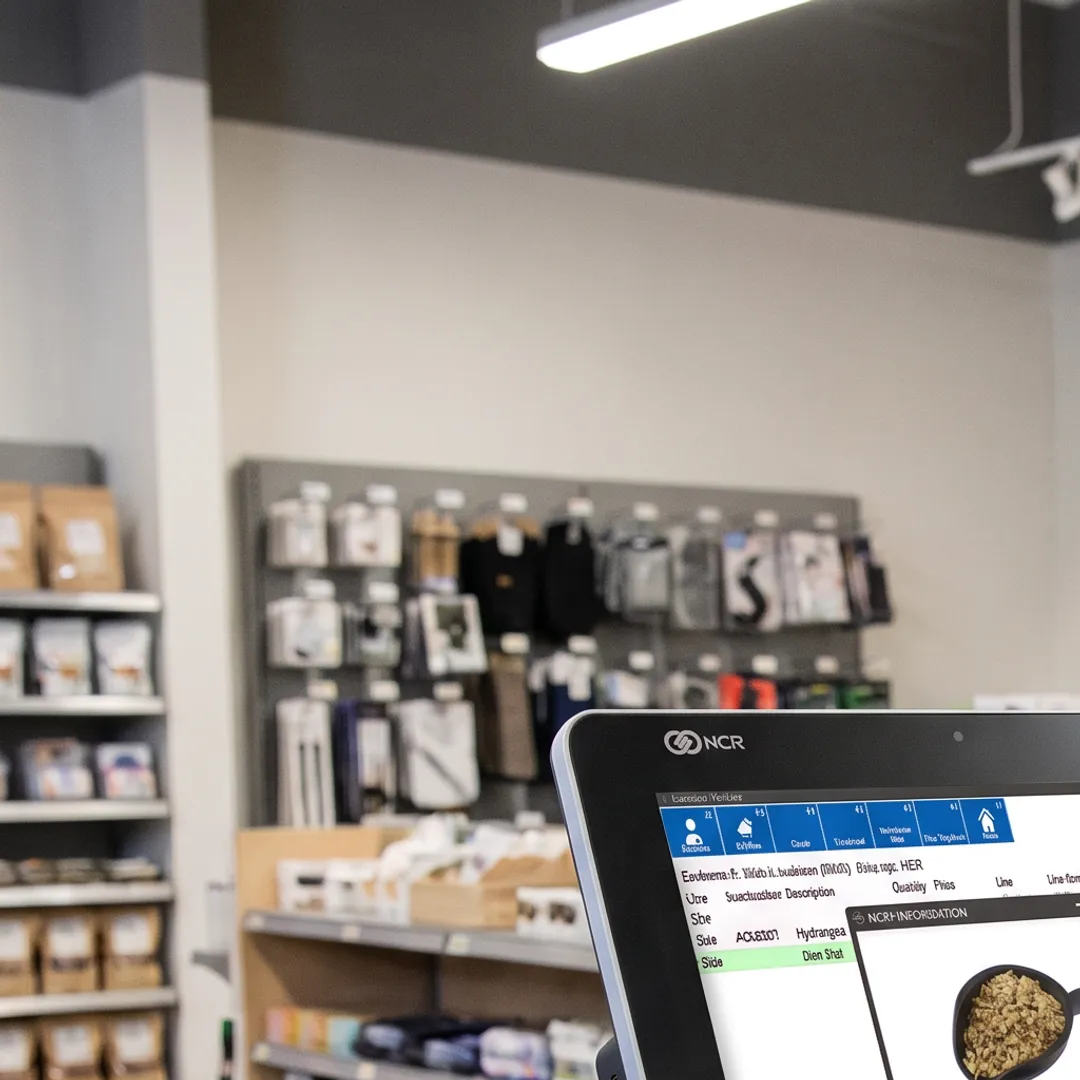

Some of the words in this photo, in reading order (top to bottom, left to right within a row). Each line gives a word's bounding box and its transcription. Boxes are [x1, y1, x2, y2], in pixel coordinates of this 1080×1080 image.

[703, 735, 746, 750] NCR
[900, 859, 924, 872] HER
[796, 926, 847, 942] Hydrangea
